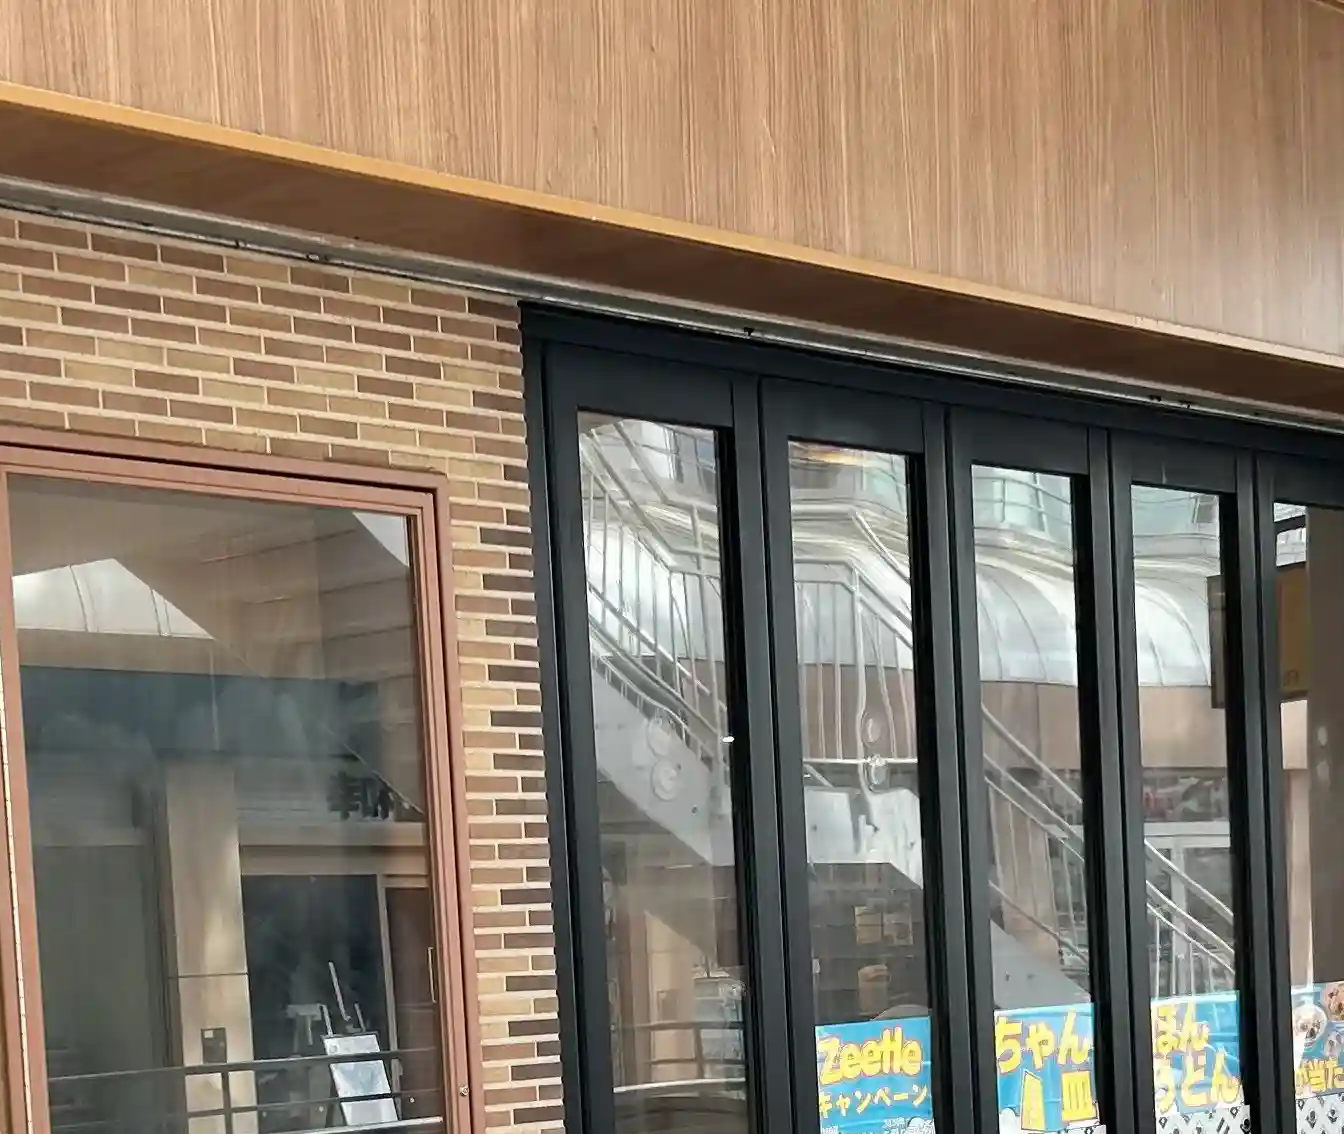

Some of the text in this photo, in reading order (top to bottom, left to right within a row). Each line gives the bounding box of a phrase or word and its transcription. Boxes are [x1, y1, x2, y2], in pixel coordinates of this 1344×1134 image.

[996, 1009, 1093, 1075] ちゃん
[818, 1083, 928, 1119] キャンペーン
